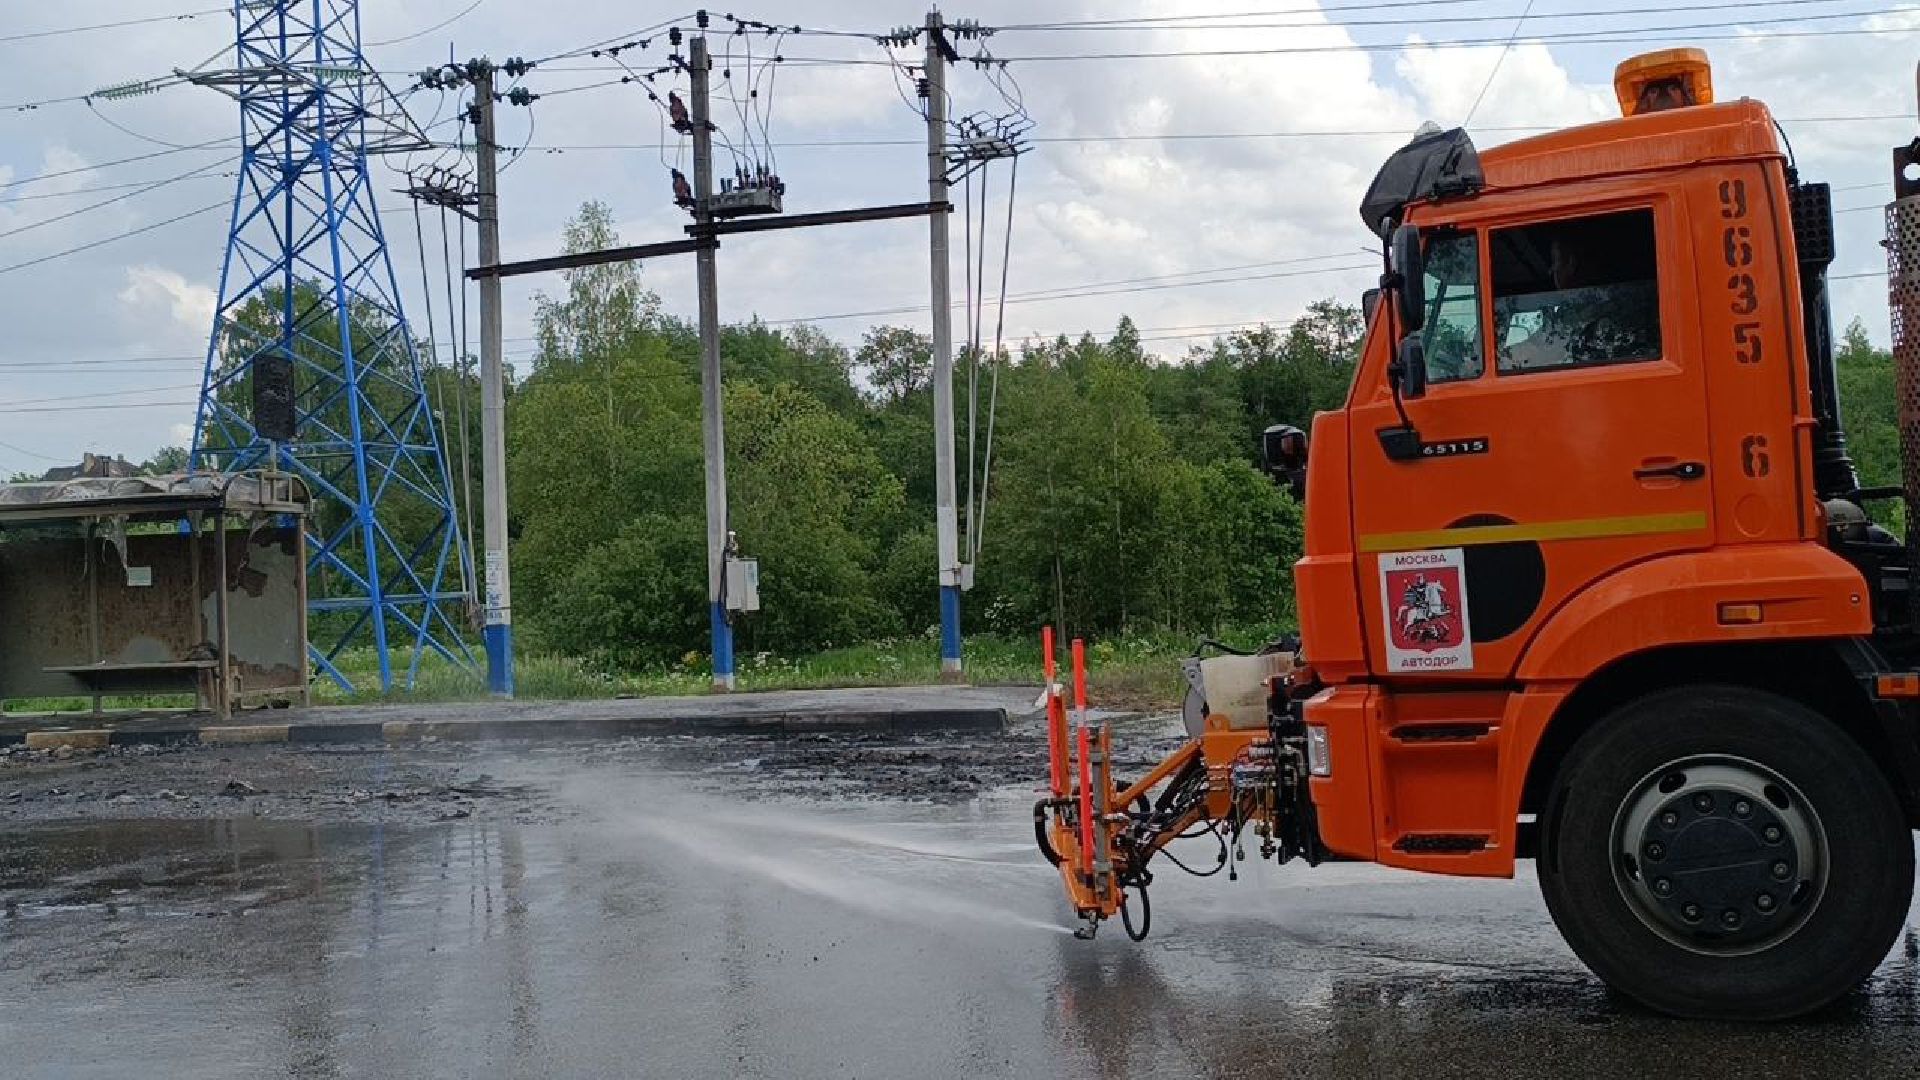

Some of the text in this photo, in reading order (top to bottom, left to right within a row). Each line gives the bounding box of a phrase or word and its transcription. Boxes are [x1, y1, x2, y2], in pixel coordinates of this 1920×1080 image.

[1719, 179, 1762, 364] 9635
[1423, 441, 1483, 455] 65115
[1741, 435, 1770, 478] 6
[1395, 554, 1447, 565] МОСКВА
[1401, 656, 1459, 667] АВТОДОР
